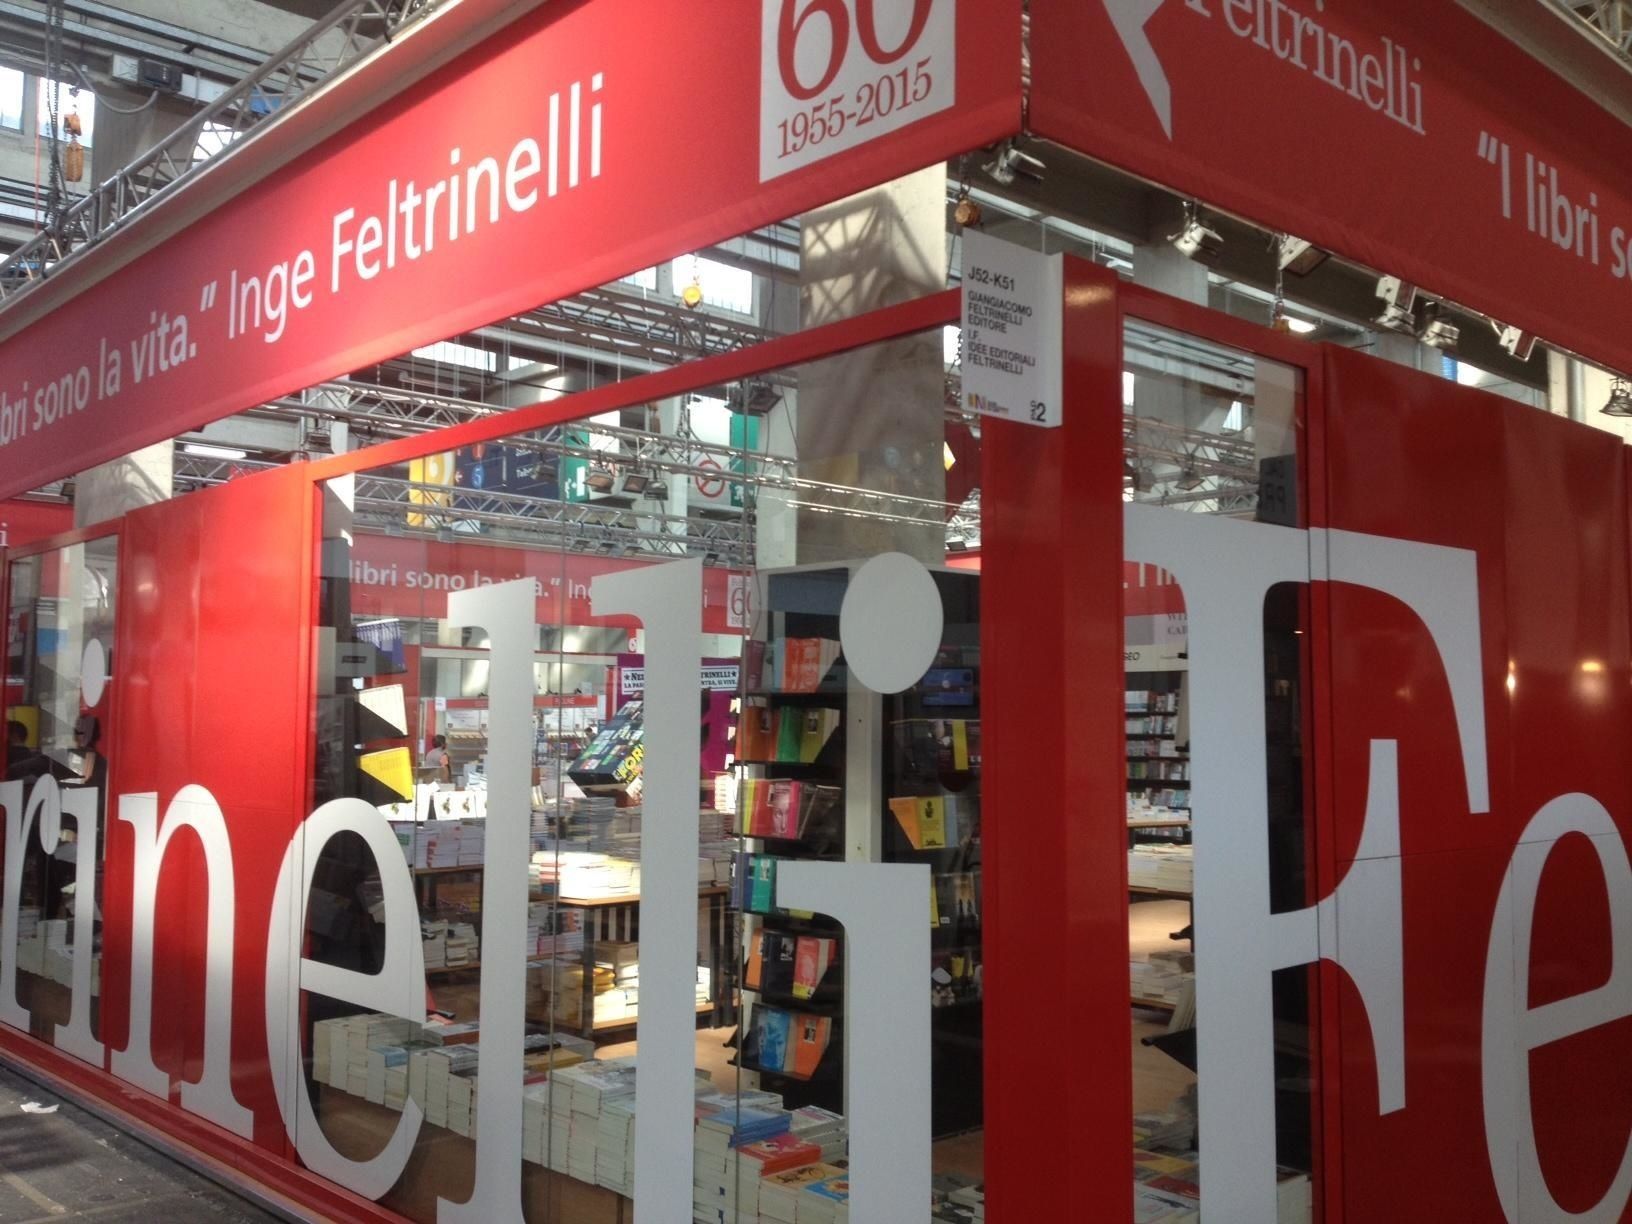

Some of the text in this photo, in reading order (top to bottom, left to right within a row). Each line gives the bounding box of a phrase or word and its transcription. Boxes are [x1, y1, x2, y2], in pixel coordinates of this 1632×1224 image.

[1186, 0, 1426, 136] eltrinelli
[777, 56, 932, 159] 1955-2015
[1526, 152, 1599, 265] libri
[1610, 226, 1632, 280] s
[33, 366, 90, 431] sono
[99, 337, 121, 400] la
[229, 249, 315, 343] Inge
[331, 72, 604, 293] Feltrinelli
[968, 266, 1014, 292] J52-K51
[968, 290, 1033, 317] GIANGIACOMO
[968, 302, 1023, 326] FELTRINELLI
[968, 313, 1007, 334] EDITORE
[968, 341, 1036, 367] IDEE EDITORIALI
[968, 353, 1024, 375] FELTRINELLI
[1036, 402, 1046, 422] 2
[405, 570, 465, 591] sono
